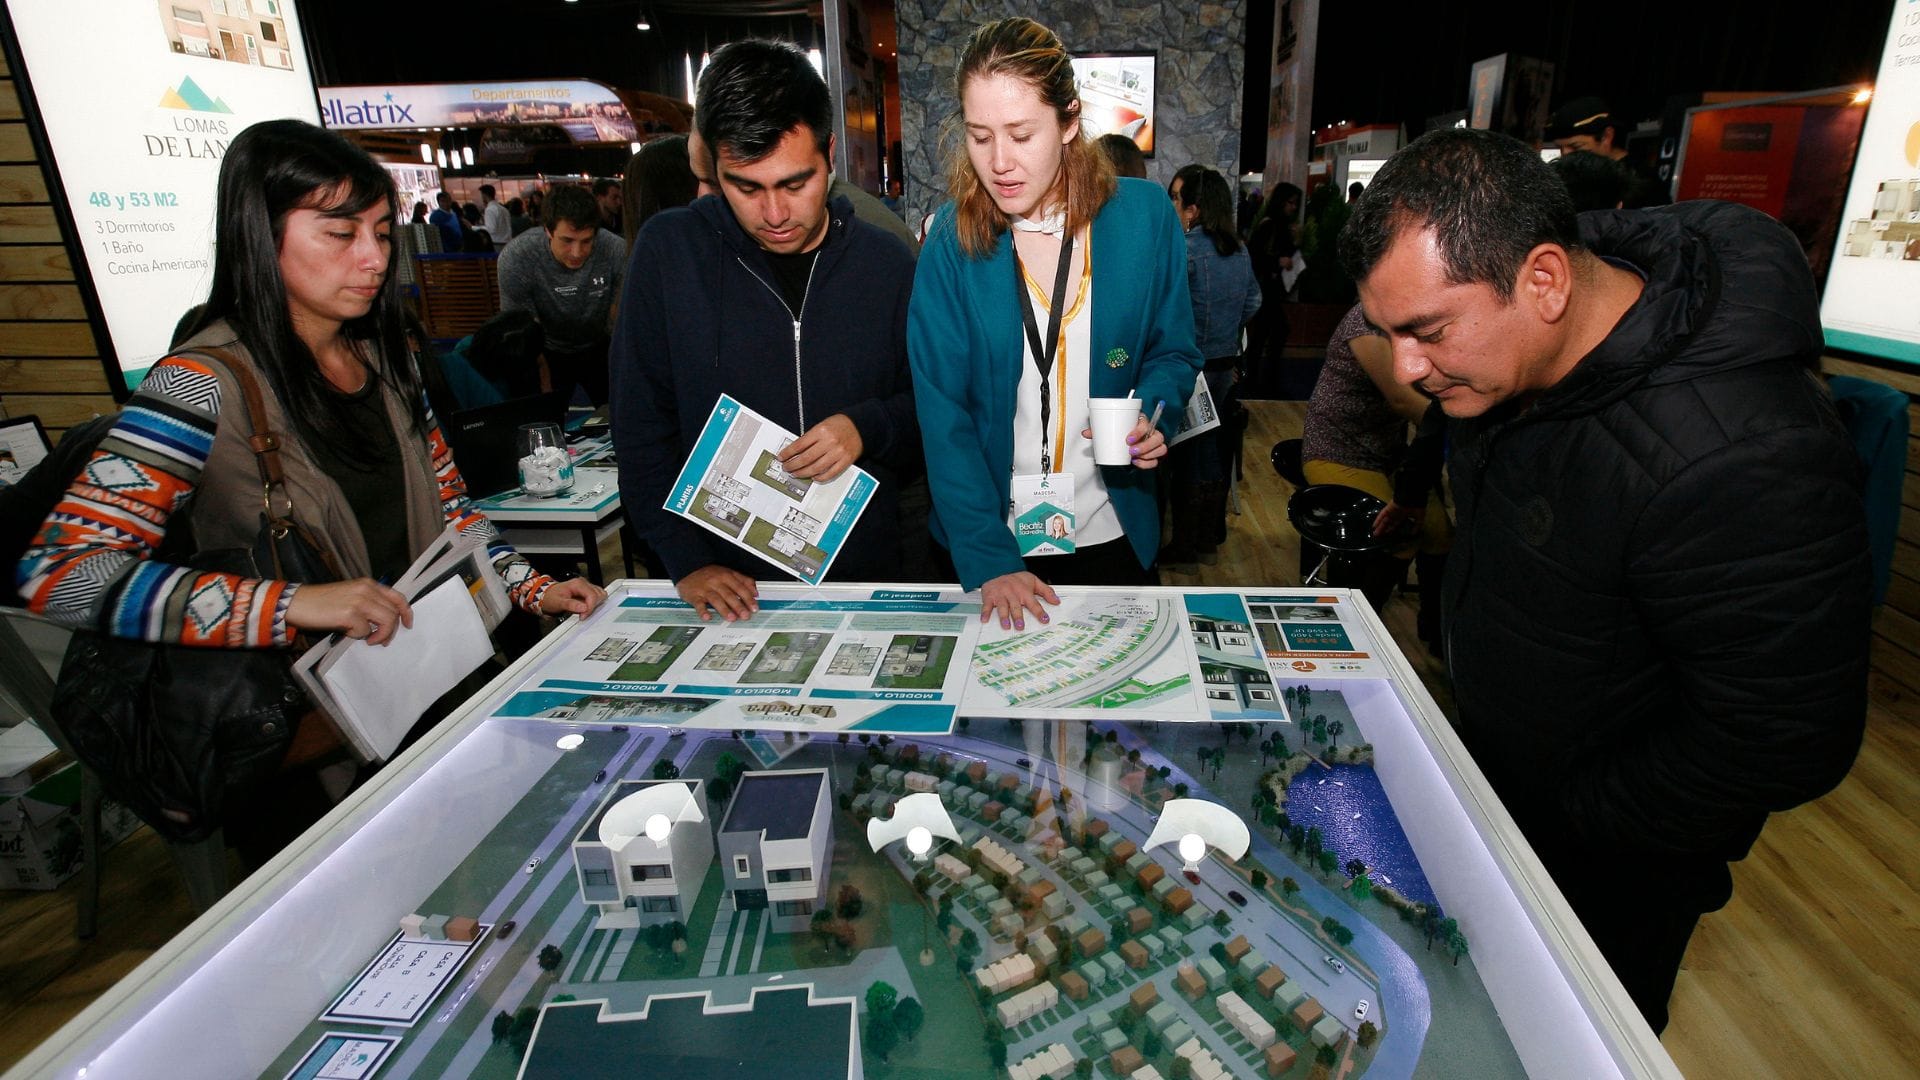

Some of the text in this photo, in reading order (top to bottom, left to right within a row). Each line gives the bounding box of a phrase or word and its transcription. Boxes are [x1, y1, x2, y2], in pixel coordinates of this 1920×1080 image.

[472, 88, 571, 102] Departamentos
[173, 116, 229, 135] LOMAS
[143, 134, 182, 157] DE
[89, 191, 178, 211] 48 y 53 M2
[94, 220, 176, 235] 3 Dormitorios
[102, 240, 144, 255] 1 Baño
[107, 258, 209, 275] Cocina Americana
[676, 484, 694, 509] PLANTAS
[746, 703, 834, 718] La Piedra
[388, 954, 405, 969] CASA
[408, 950, 428, 967] CASA
[435, 951, 453, 969] CASA
